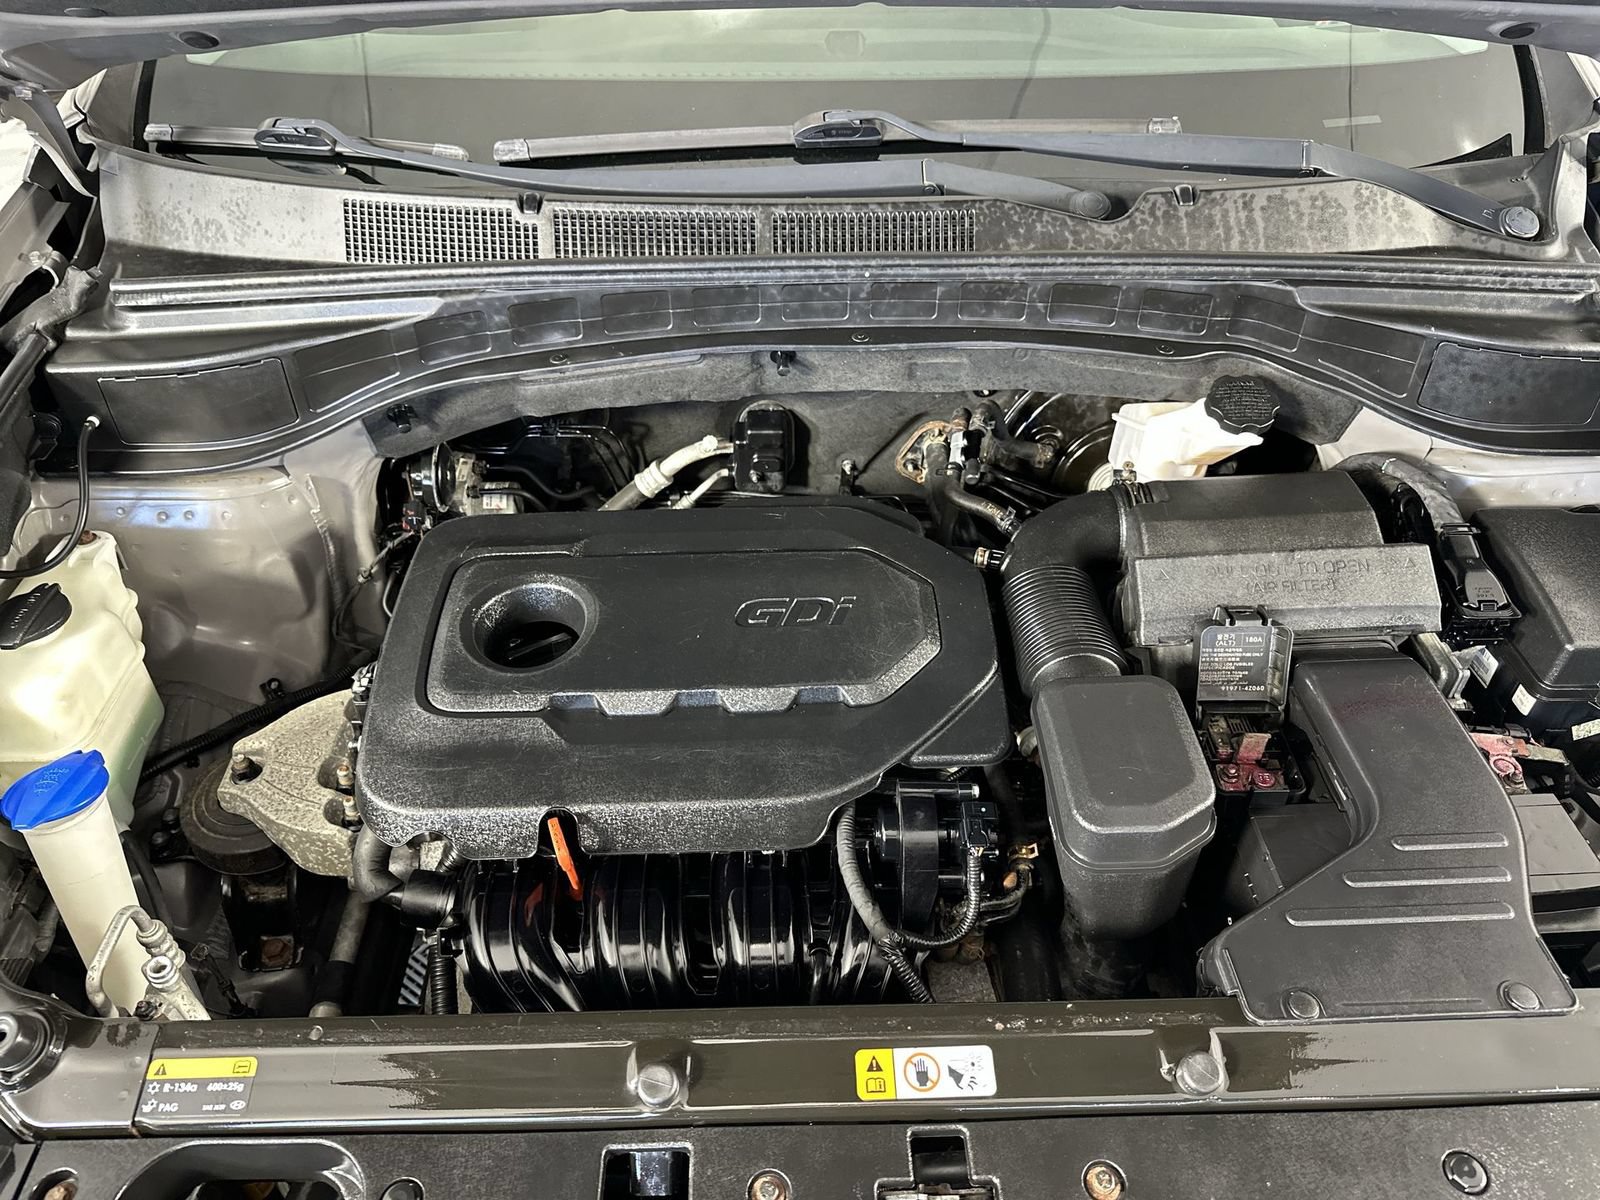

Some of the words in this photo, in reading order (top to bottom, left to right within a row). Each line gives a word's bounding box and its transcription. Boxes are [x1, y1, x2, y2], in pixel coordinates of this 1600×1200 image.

[1299, 561, 1318, 576] TO
[1323, 559, 1371, 574] OPEN
[1282, 577, 1337, 593] FILTER)
[163, 1082, 198, 1092] R-134a
[158, 1103, 179, 1112] PAG
